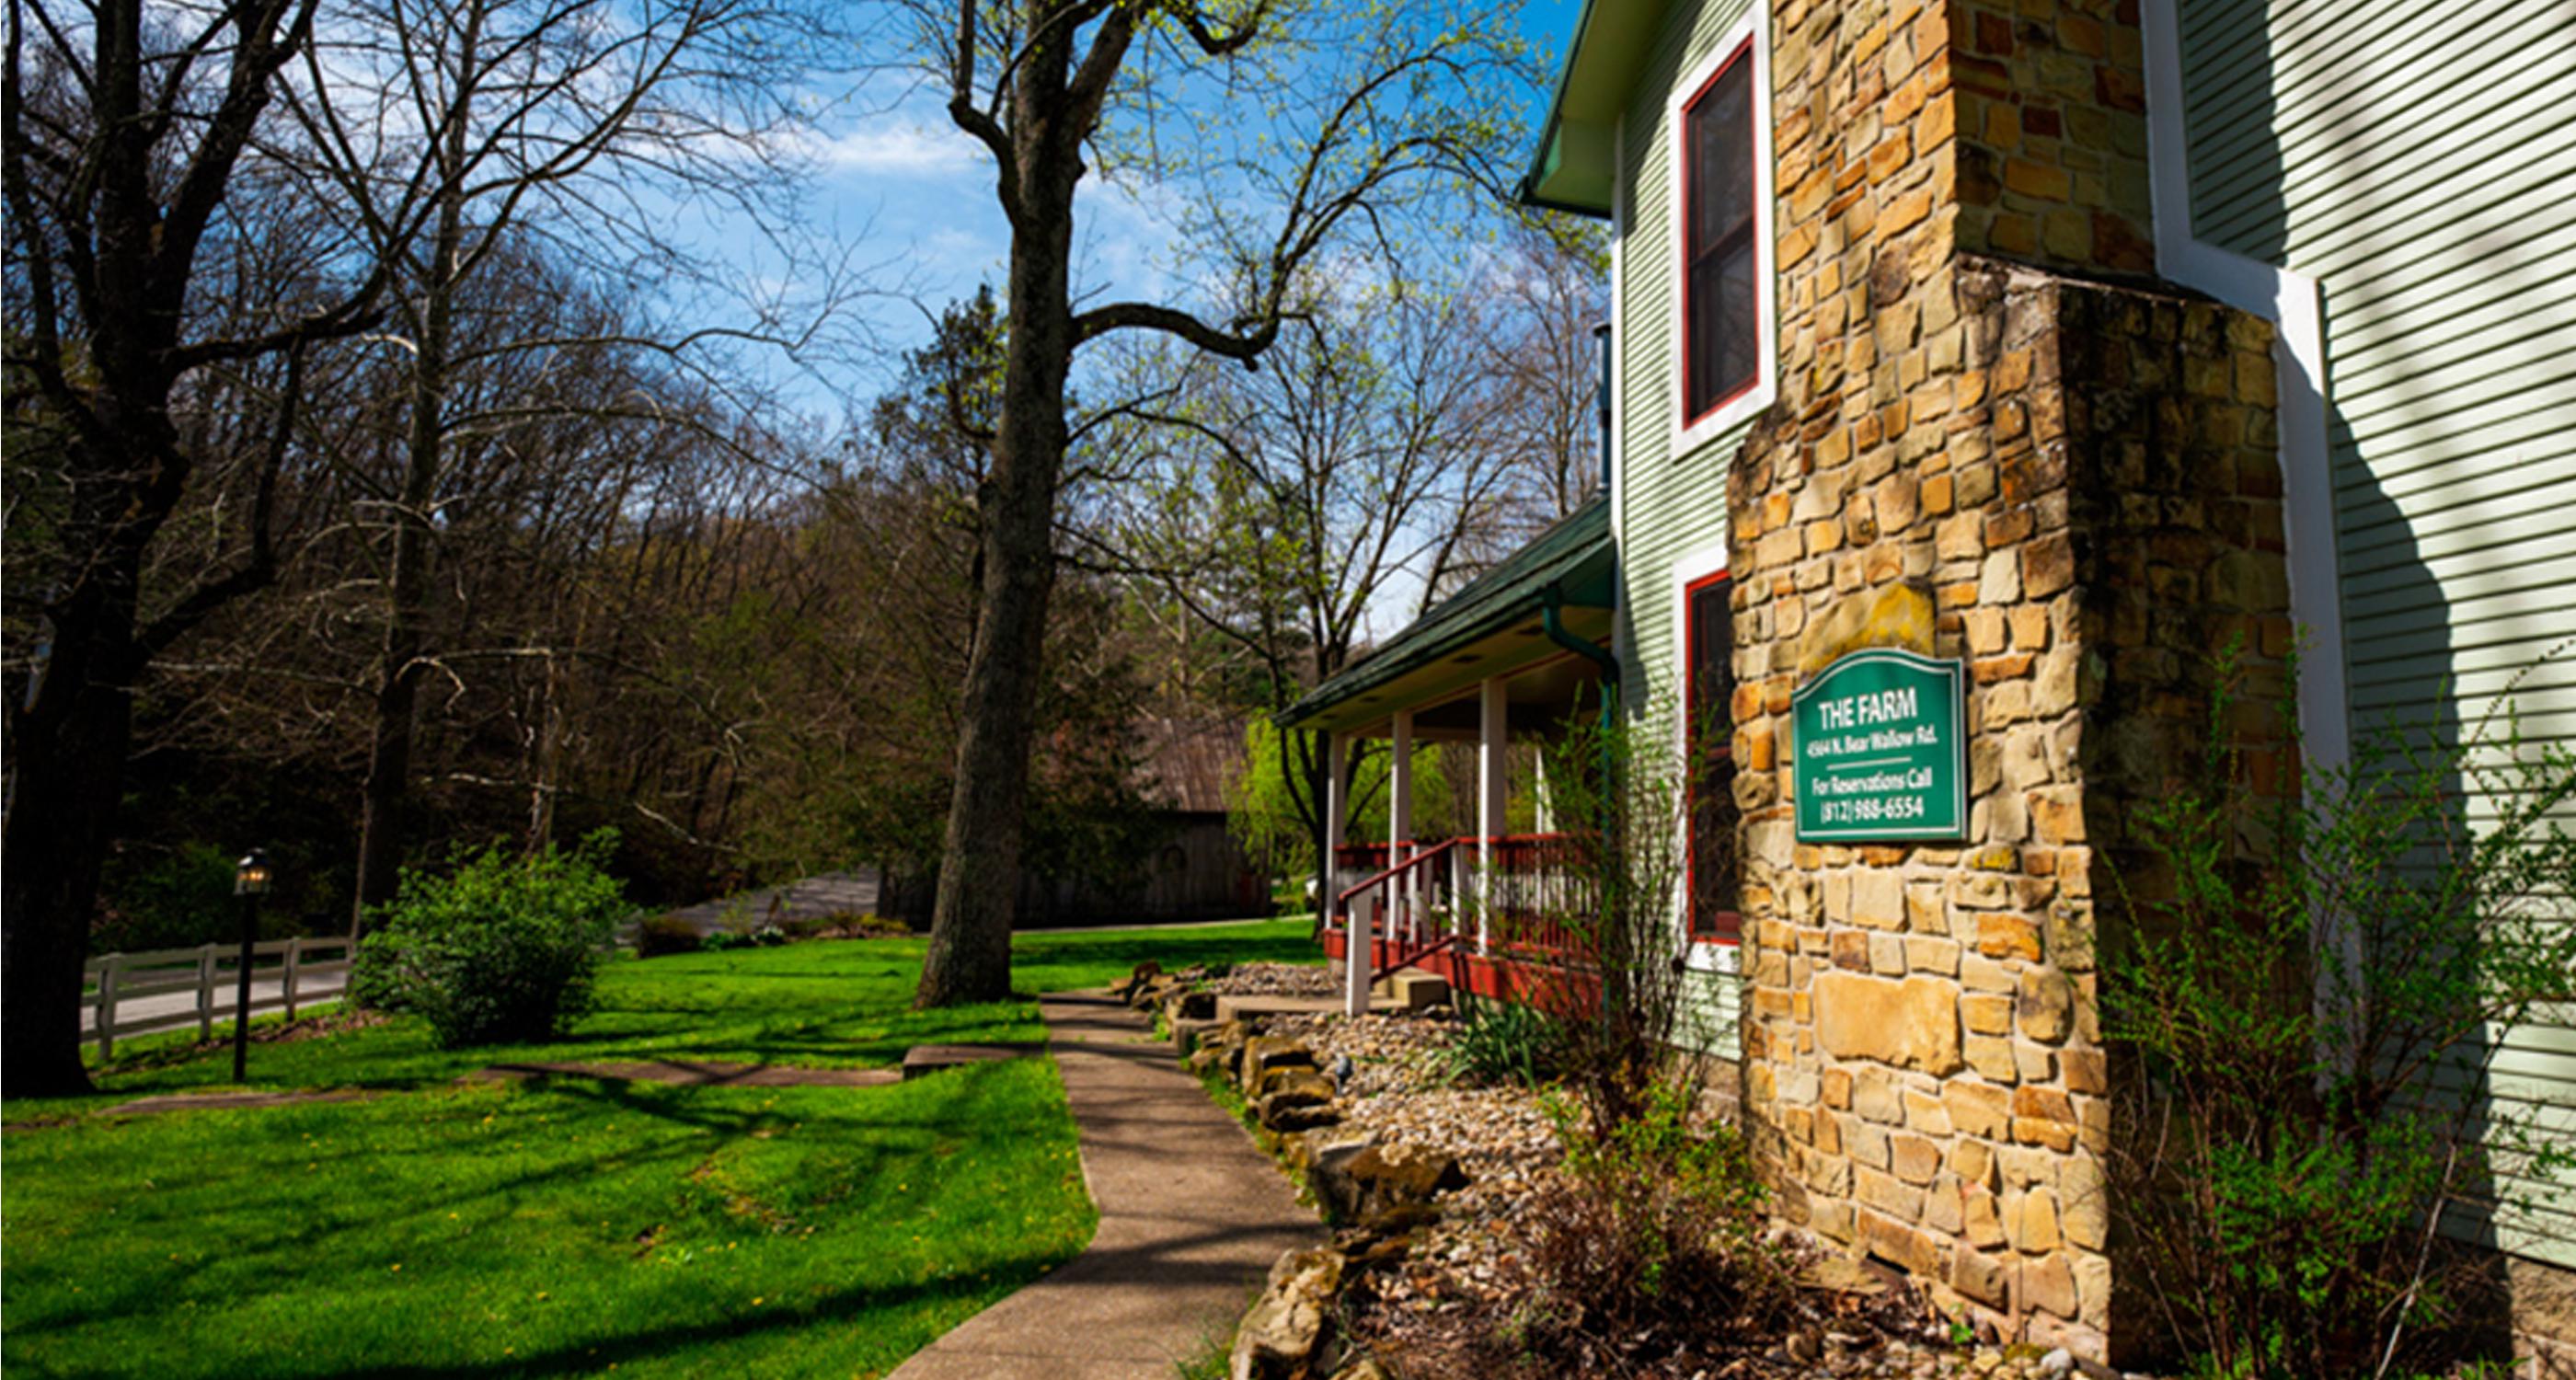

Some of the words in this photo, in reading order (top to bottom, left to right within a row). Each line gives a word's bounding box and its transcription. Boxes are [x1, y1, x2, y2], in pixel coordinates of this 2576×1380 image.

[1818, 696, 1855, 730] THE
[1857, 687, 1918, 725] FARM
[1833, 737, 1845, 754] N.
[1846, 735, 1869, 753] Bear
[1871, 730, 1915, 750] Wallow
[1916, 724, 1938, 744] Rd.
[1812, 776, 1829, 795] For
[1831, 771, 1905, 794] Reservations
[1907, 766, 1933, 788] Call
[1821, 799, 1853, 824] (812)
[1855, 796, 1925, 821] 988-6554
